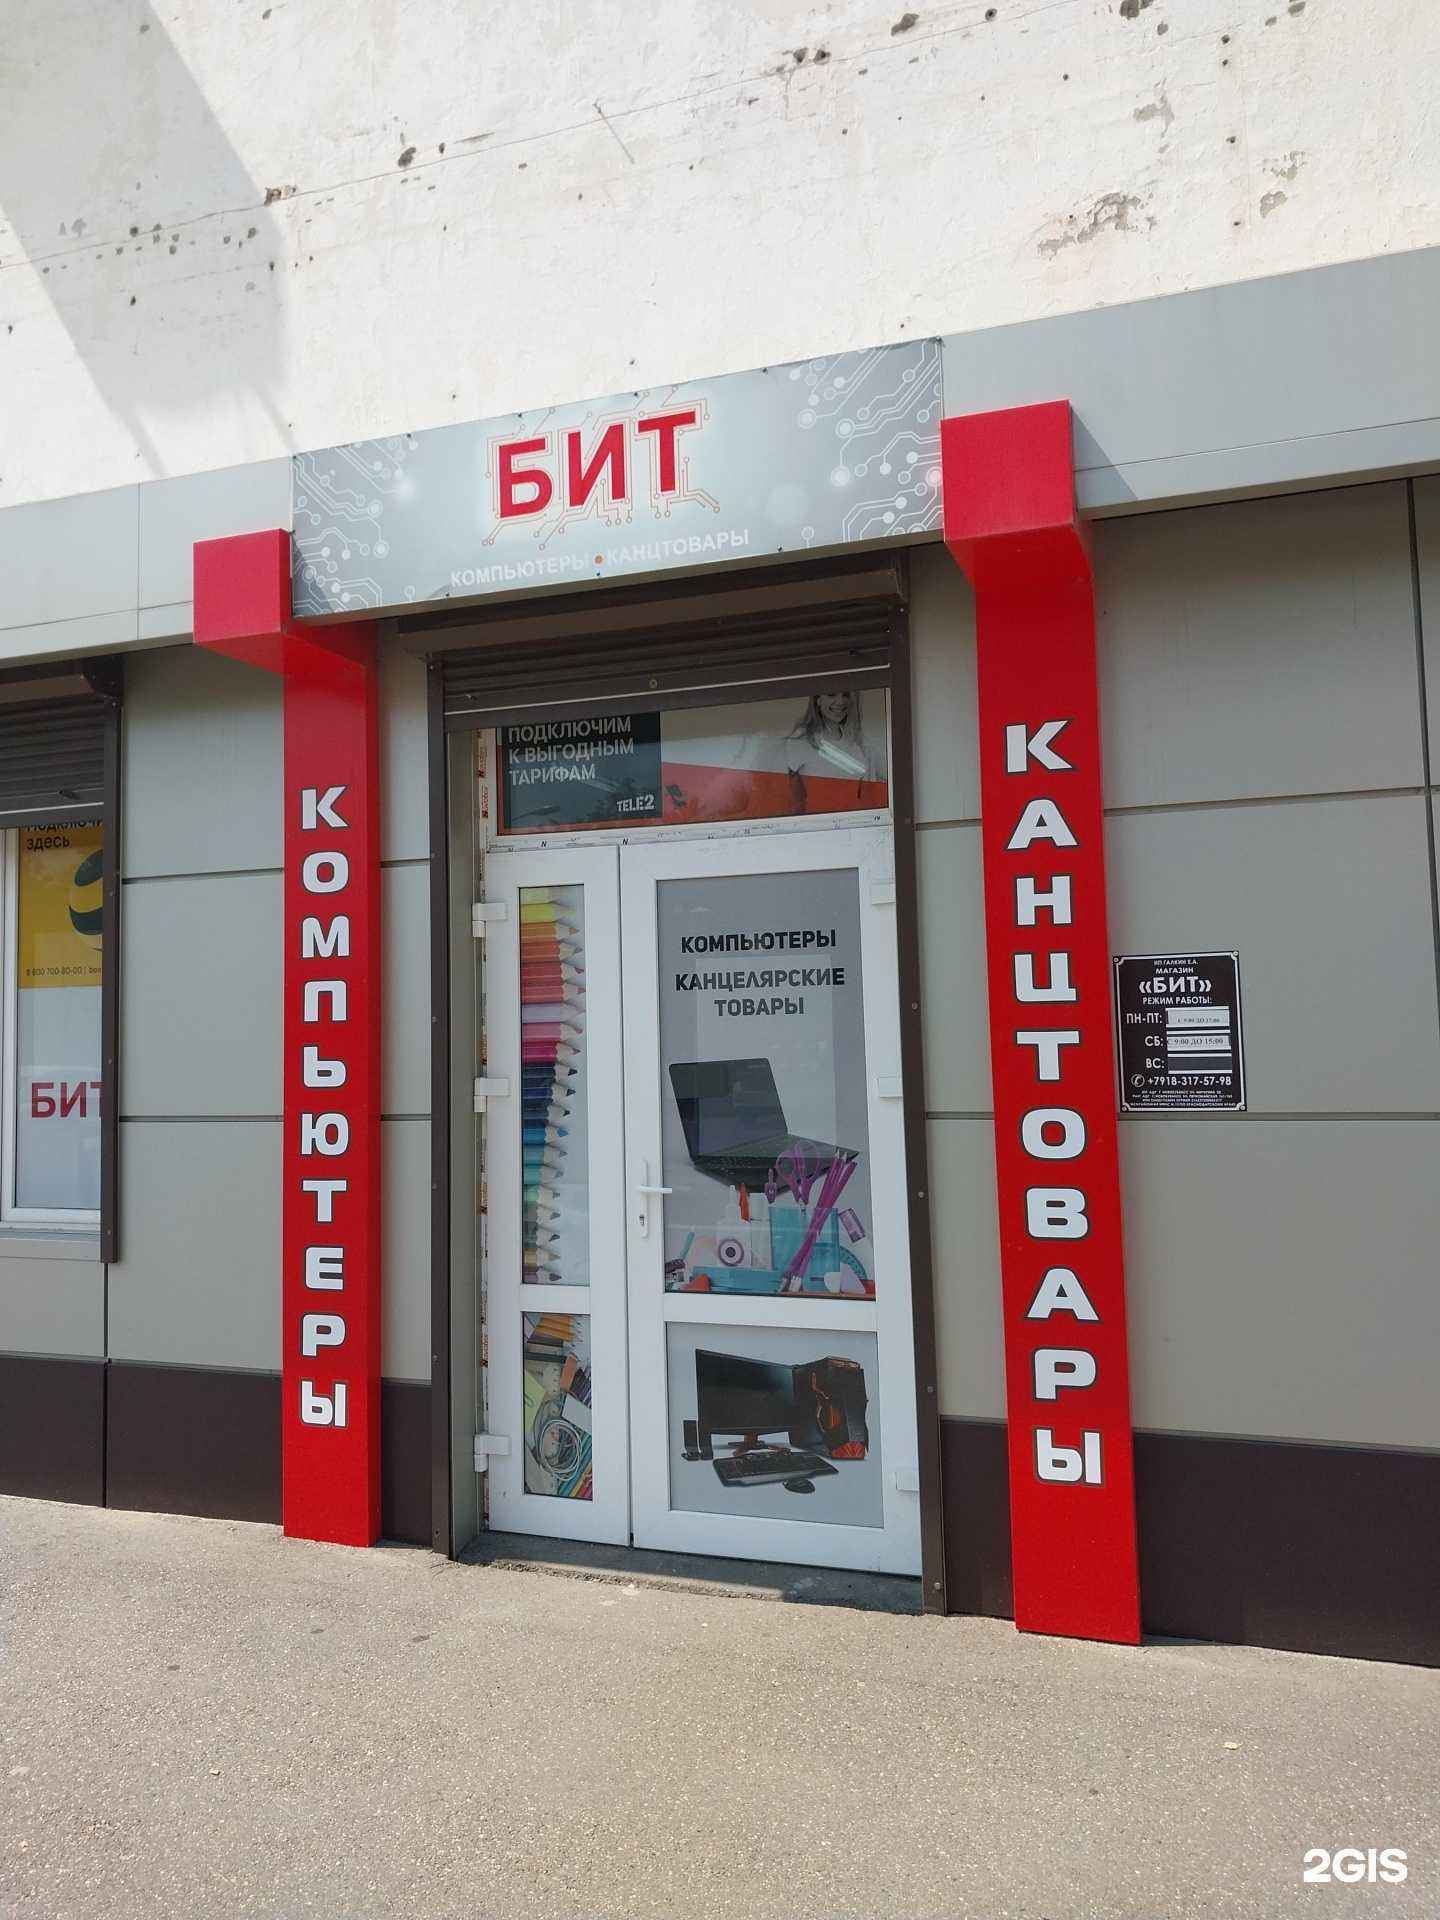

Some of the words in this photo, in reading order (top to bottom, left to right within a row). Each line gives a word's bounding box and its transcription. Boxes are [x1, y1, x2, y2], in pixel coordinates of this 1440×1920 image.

[499, 410, 697, 519] БИТ
[450, 553, 590, 588] КОМПЬЮТЕРЫ
[606, 528, 750, 566] КАНЦТОВАРЫ
[508, 716, 632, 744] ПОДКЛЮЧИМ
[509, 748, 521, 765] К
[524, 738, 634, 763] ВЫГОДНЫМ
[508, 763, 597, 787] ТАРИФАМ
[615, 793, 656, 813] TELE2
[26, 835, 70, 853] здесь
[681, 929, 836, 953] КОМПЬЮТЕРЫ
[675, 967, 845, 992] КАНЦЕЛЯРСКИЕ
[1138, 976, 1212, 994] «БИТ»
[714, 997, 805, 1017] ТОВАРЫ
[1142, 996, 1174, 1005] РЕЖИМ
[1126, 1012, 1163, 1024] ПН-ПТ:
[1144, 1035, 1164, 1047] СБ:
[1145, 1058, 1165, 1069] ВС:
[1147, 1076, 1232, 1086] +7918-317-57-98
[300, 785, 350, 1429] КОМПЬЮТЕРЫ
[1004, 719, 1104, 1486] КАНЦТОВАРЫ
